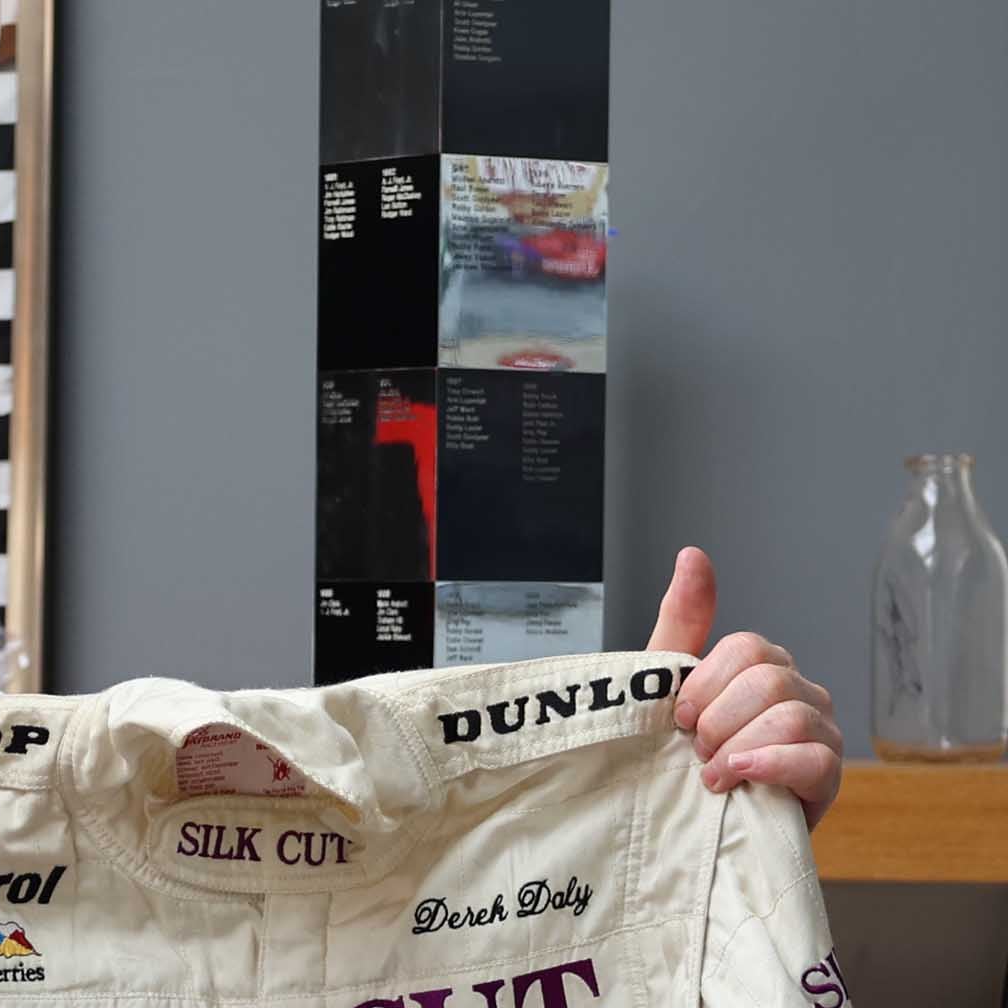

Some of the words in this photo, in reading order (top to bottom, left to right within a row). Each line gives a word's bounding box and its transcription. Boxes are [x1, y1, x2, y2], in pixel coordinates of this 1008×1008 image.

[176, 821, 262, 862] SILK
[276, 830, 353, 866] CUT
[412, 894, 508, 934] Derek
[517, 876, 592, 917] Daly
